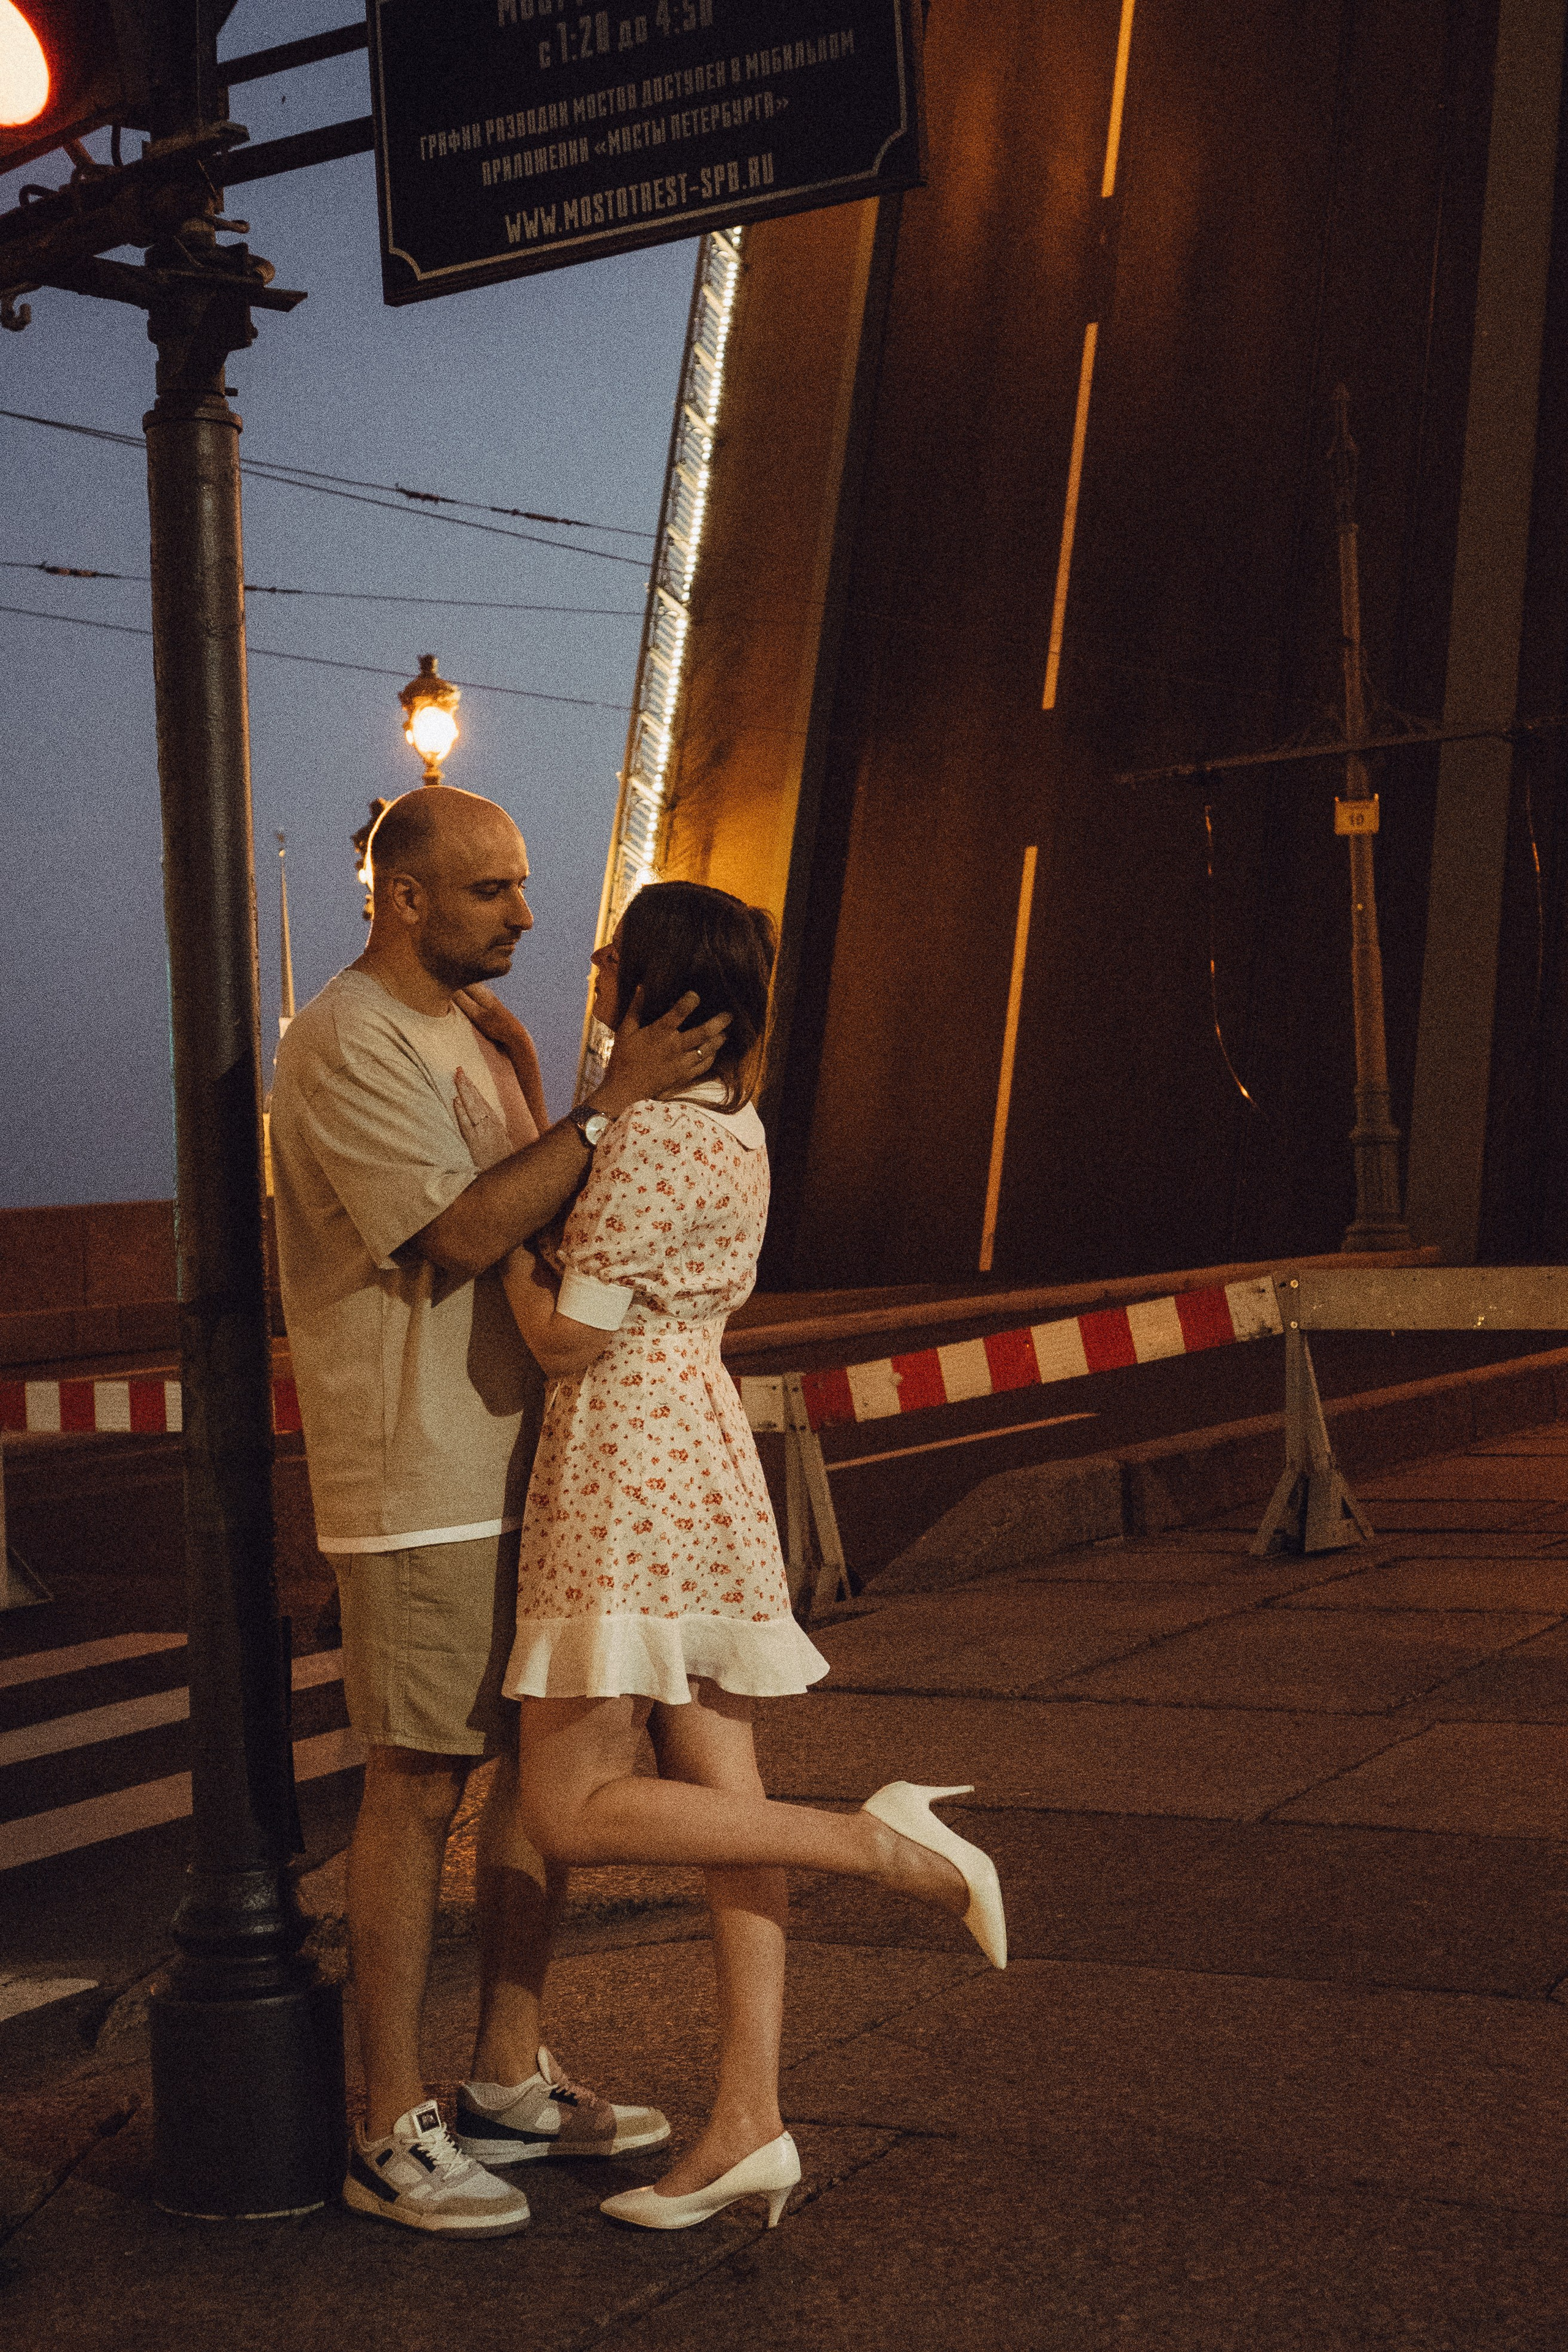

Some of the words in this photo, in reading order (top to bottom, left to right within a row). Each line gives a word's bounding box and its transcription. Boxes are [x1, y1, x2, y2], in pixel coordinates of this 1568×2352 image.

[556, 11, 610, 63] 1:20
[618, 15, 647, 51] до
[655, 0, 713, 37] 4:50
[420, 123, 481, 161] ГРАФИК
[485, 100, 569, 145] РАЗВОДКИ
[573, 83, 637, 123] МОСТОВ
[642, 61, 726, 108] ДОСТУПЕН
[731, 57, 741, 83] В
[745, 28, 855, 80] МОБИЛЬНОМ
[481, 137, 589, 186] ПРИЛОЖЕНИИ
[594, 118, 666, 156] «МОСТЫ
[671, 91, 789, 141] ПЕТЕРБУРГА»
[504, 153, 774, 244] WWW.MOSTOTREST-SPB.RU
